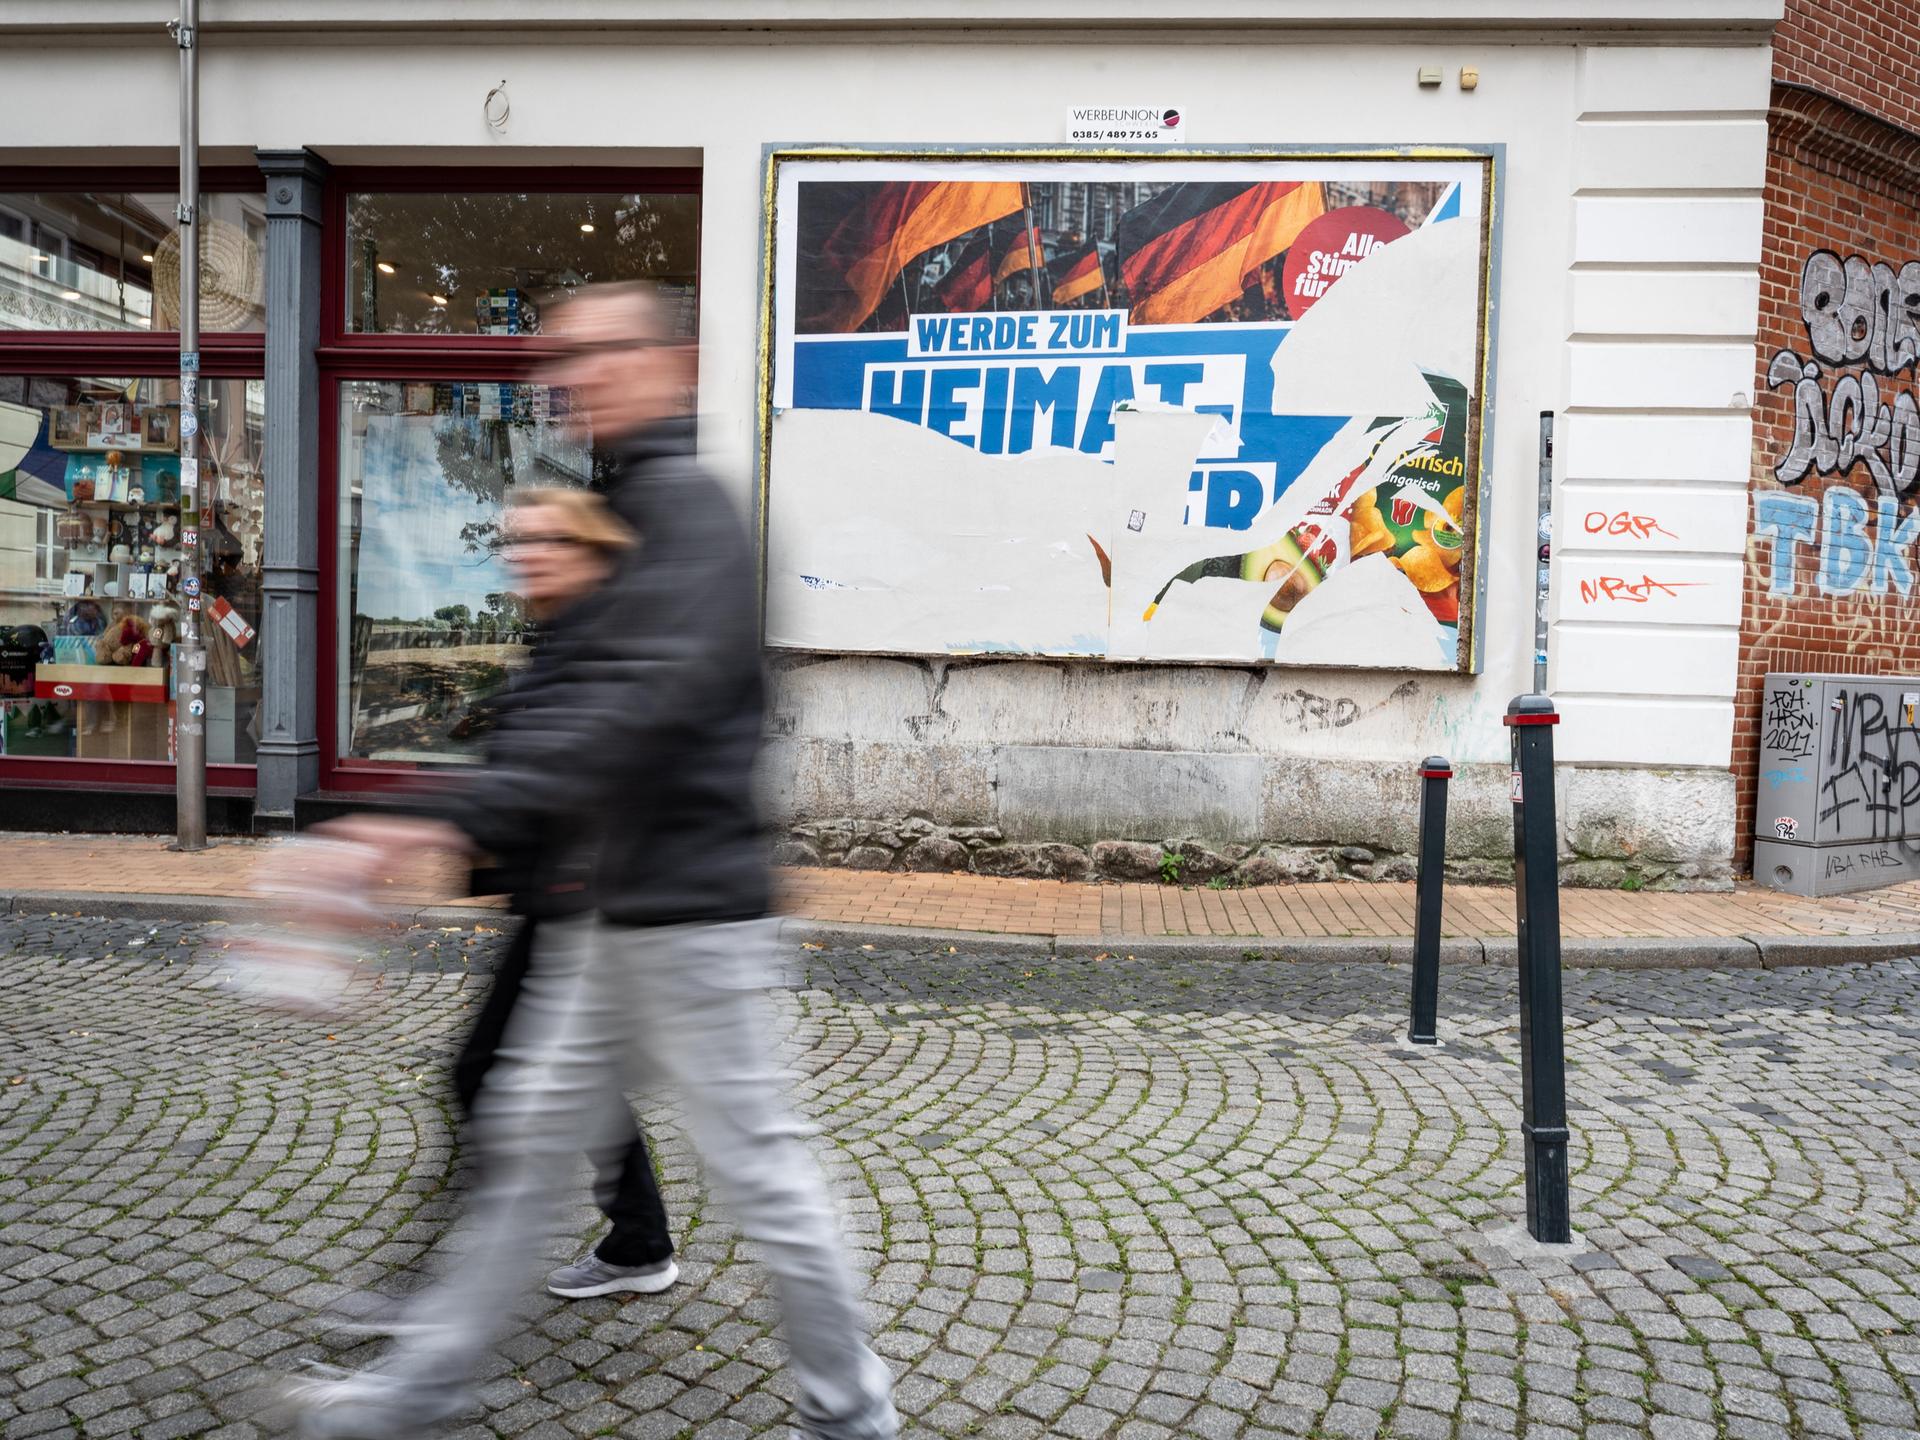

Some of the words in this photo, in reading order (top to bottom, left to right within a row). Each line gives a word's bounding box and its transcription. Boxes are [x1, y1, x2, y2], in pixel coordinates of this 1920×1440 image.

[1073, 109, 1159, 121] WERBEUNION
[1072, 130, 1104, 140] 0385/
[1107, 131, 1127, 139] 489
[1129, 131, 1142, 139] 75
[1144, 131, 1158, 139] 65
[1294, 273, 1328, 297] für
[916, 316, 1038, 352] WERDE
[1048, 313, 1121, 349] ZUM
[1752, 485, 1920, 601] TBK
[1765, 728, 1812, 758] 2011
